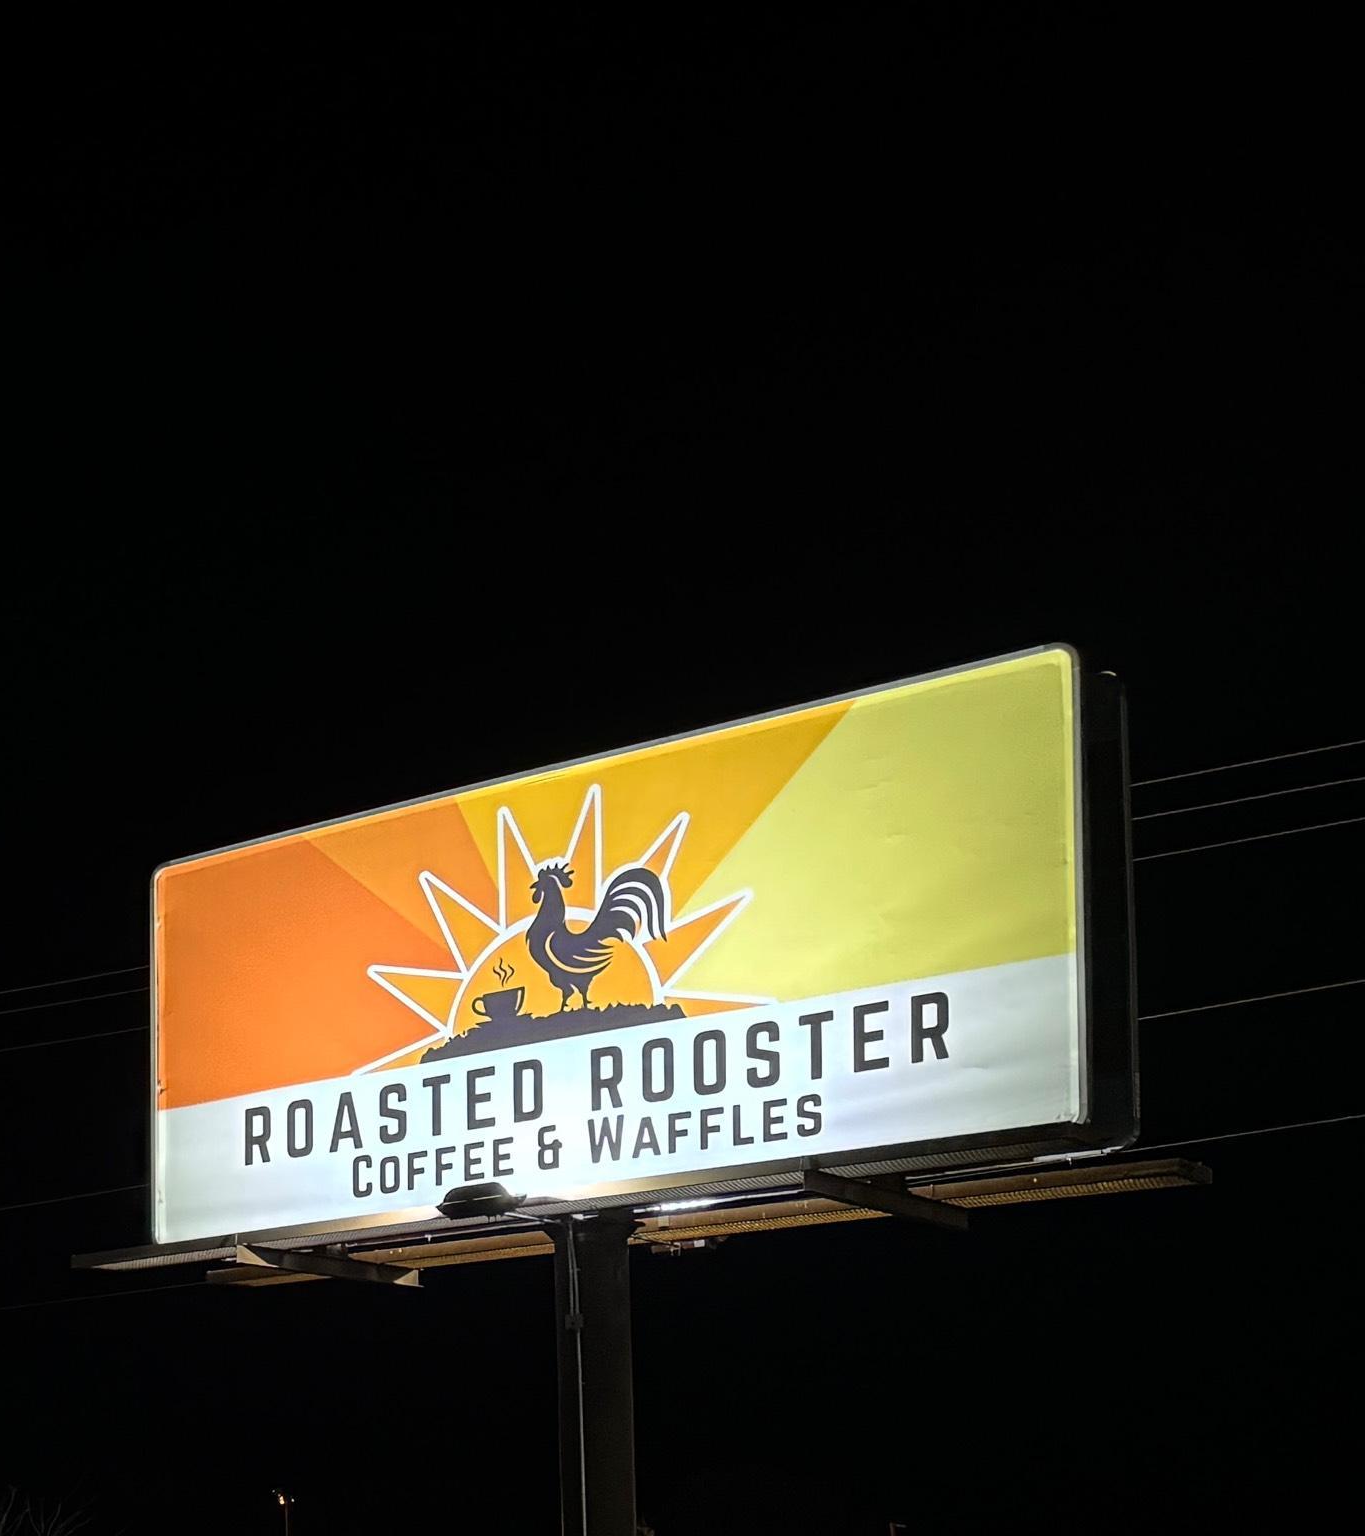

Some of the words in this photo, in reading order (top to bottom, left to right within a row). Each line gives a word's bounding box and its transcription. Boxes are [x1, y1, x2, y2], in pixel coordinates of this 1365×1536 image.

[245, 1059, 543, 1165] ROASTED
[591, 992, 949, 1111] ROOSTER
[352, 1136, 514, 1198] COFFEE
[538, 1125, 563, 1170] &
[588, 1094, 822, 1163] WAFFLES
